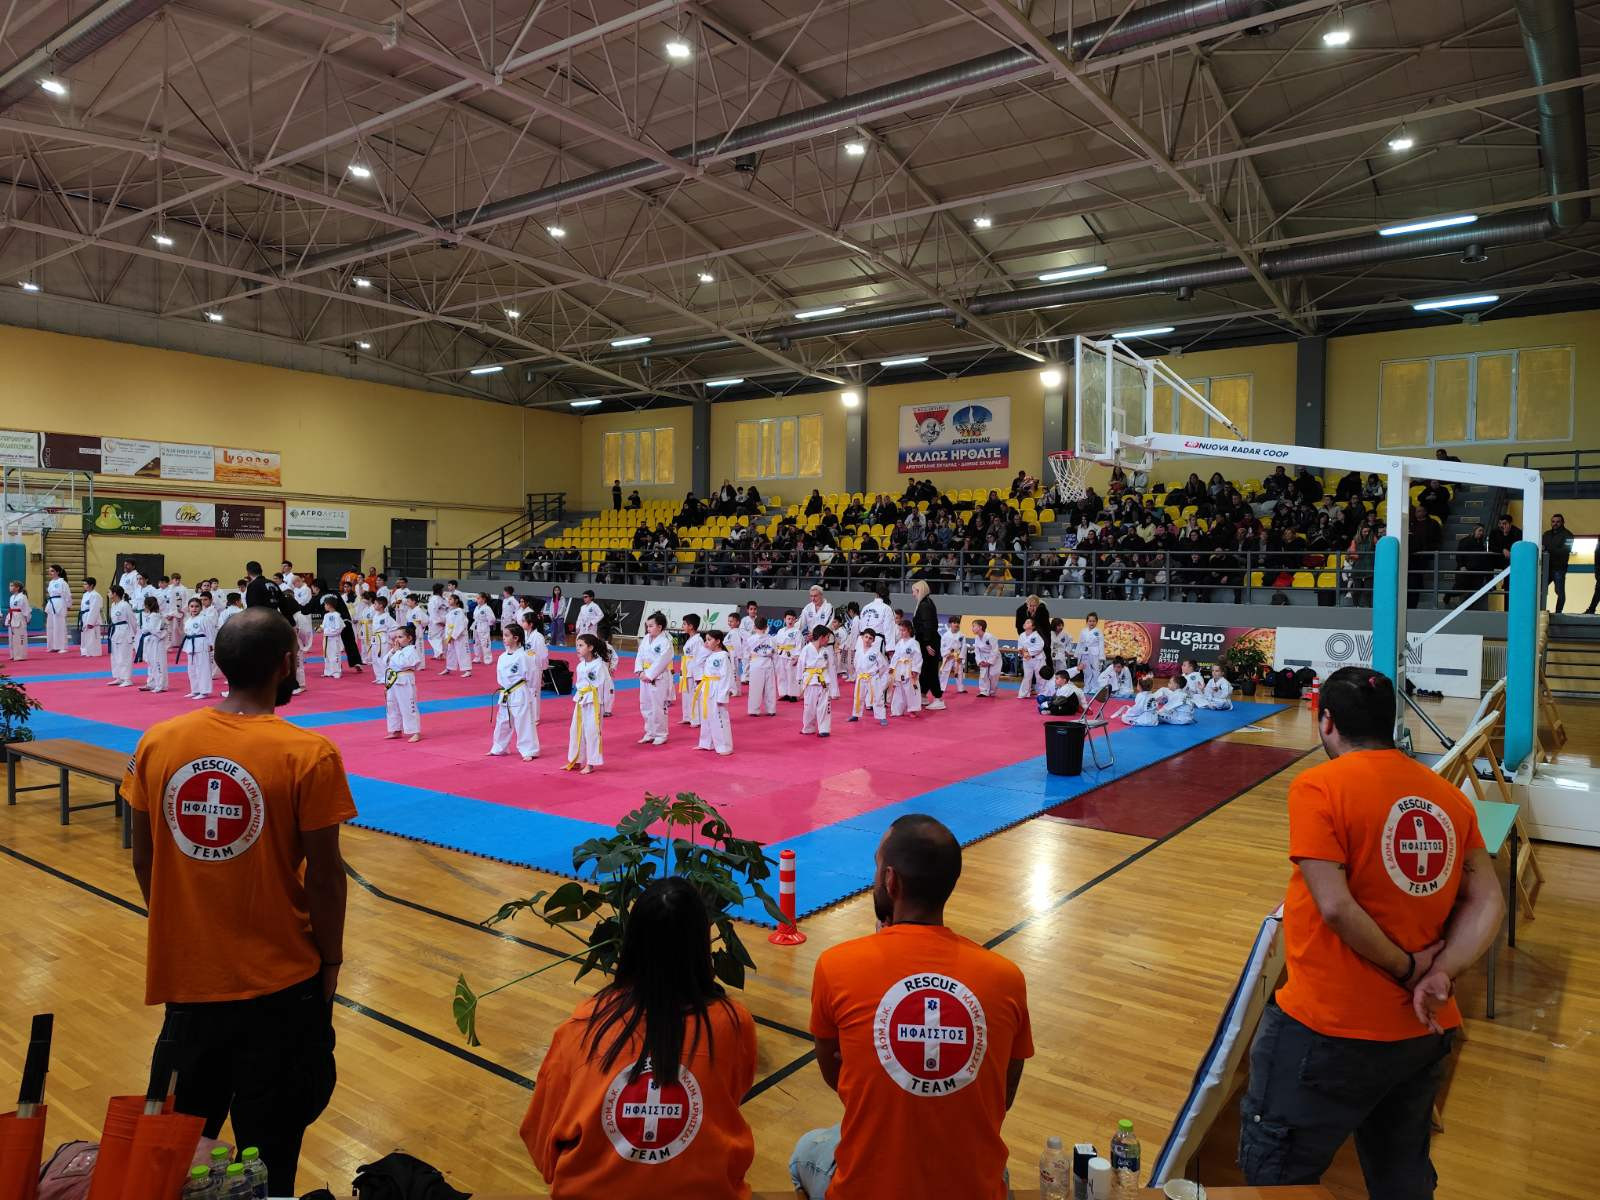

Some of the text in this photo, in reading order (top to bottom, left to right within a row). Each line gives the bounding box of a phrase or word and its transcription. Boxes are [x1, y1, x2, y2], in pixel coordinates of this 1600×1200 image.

[905, 448, 1001, 463] ΚΑΛΩΣ ΗΡΘΑΤΕ
[1199, 443, 1229, 452] NUOVA
[1231, 446, 1261, 455] RADAR
[1263, 449, 1289, 458] COOP
[1160, 626, 1225, 645] Lugano
[1192, 643, 1220, 651] pizza
[1325, 632, 1423, 665] OVN
[192, 759, 239, 777] RESCUE
[184, 803, 241, 817] ΗΦΑΙΣΤΟΣ
[1398, 799, 1433, 813] RESCUE
[192, 845, 234, 858] TEAM
[1401, 842, 1443, 851] ΗΦΑΙΣΤΟΣ
[1408, 881, 1438, 893] TEAM
[904, 976, 958, 994] RESCUE
[900, 1027, 964, 1041] ΗΦΑΙΣΤΟΣ
[911, 1078, 957, 1093] TEAM
[625, 1105, 680, 1116] ΗΦΑΙΣΤΟΣ
[630, 1147, 671, 1160] TEAM
